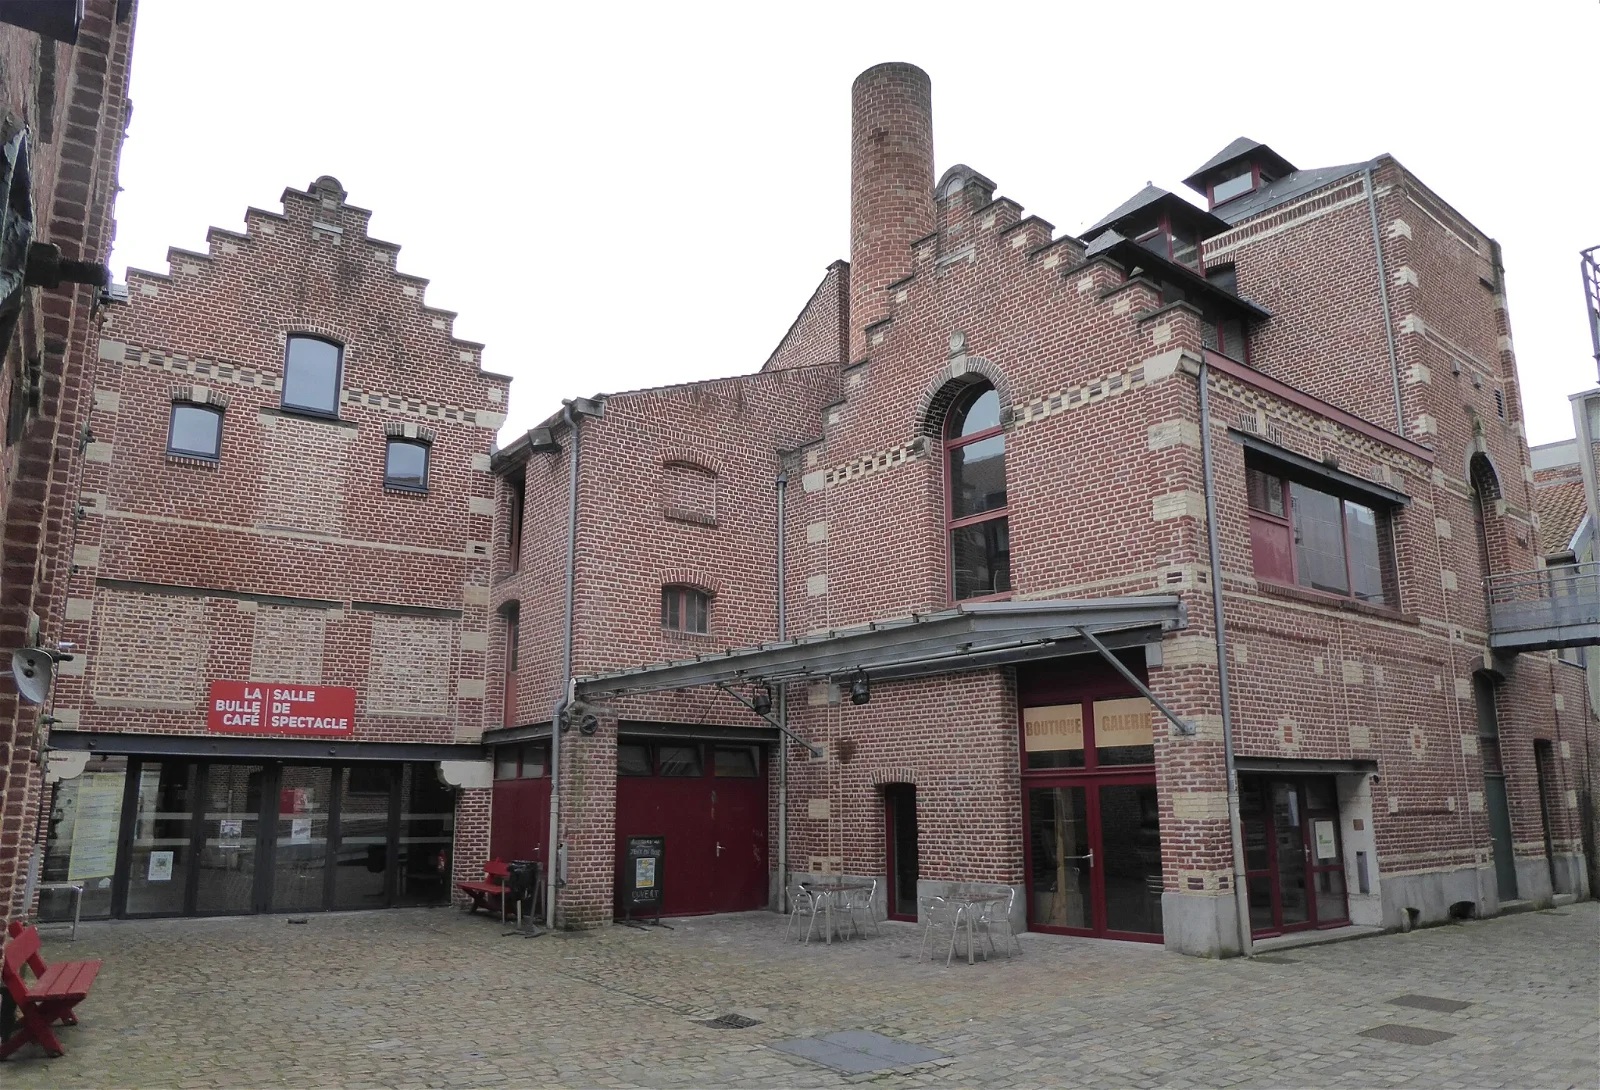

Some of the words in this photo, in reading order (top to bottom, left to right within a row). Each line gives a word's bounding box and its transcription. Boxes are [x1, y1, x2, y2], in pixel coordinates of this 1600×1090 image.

[244, 687, 262, 699] LA
[273, 689, 315, 702] SALLE
[215, 699, 261, 713] BULLE
[272, 702, 291, 714] DE
[223, 712, 260, 726] CAFÉ
[271, 715, 348, 729] SPECTACLE
[1102, 713, 1151, 731] GALERIE
[1026, 718, 1081, 736] BOUTIQUE
